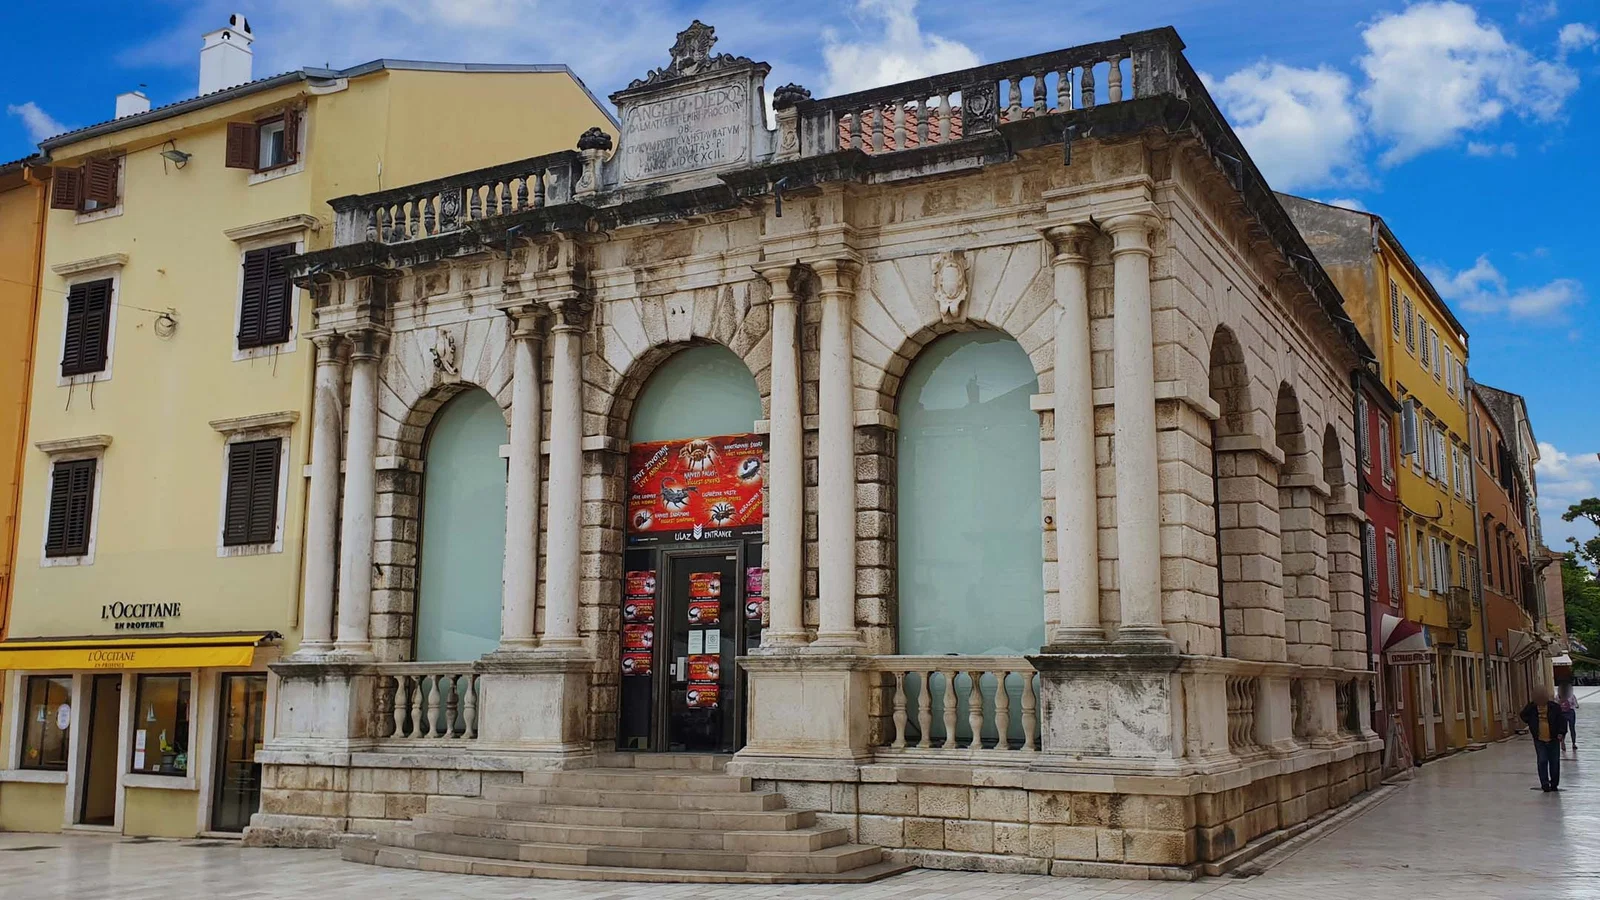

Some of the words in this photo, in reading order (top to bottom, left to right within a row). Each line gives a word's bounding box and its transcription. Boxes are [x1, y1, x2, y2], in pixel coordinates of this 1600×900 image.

[674, 532, 692, 541] ULAZ
[704, 530, 732, 539] ENTRANCE
[101, 601, 180, 619] L'OCCITANE
[115, 622, 124, 630] EN
[126, 621, 164, 630] PROVENCE
[88, 650, 135, 661] L'OCCITANE
